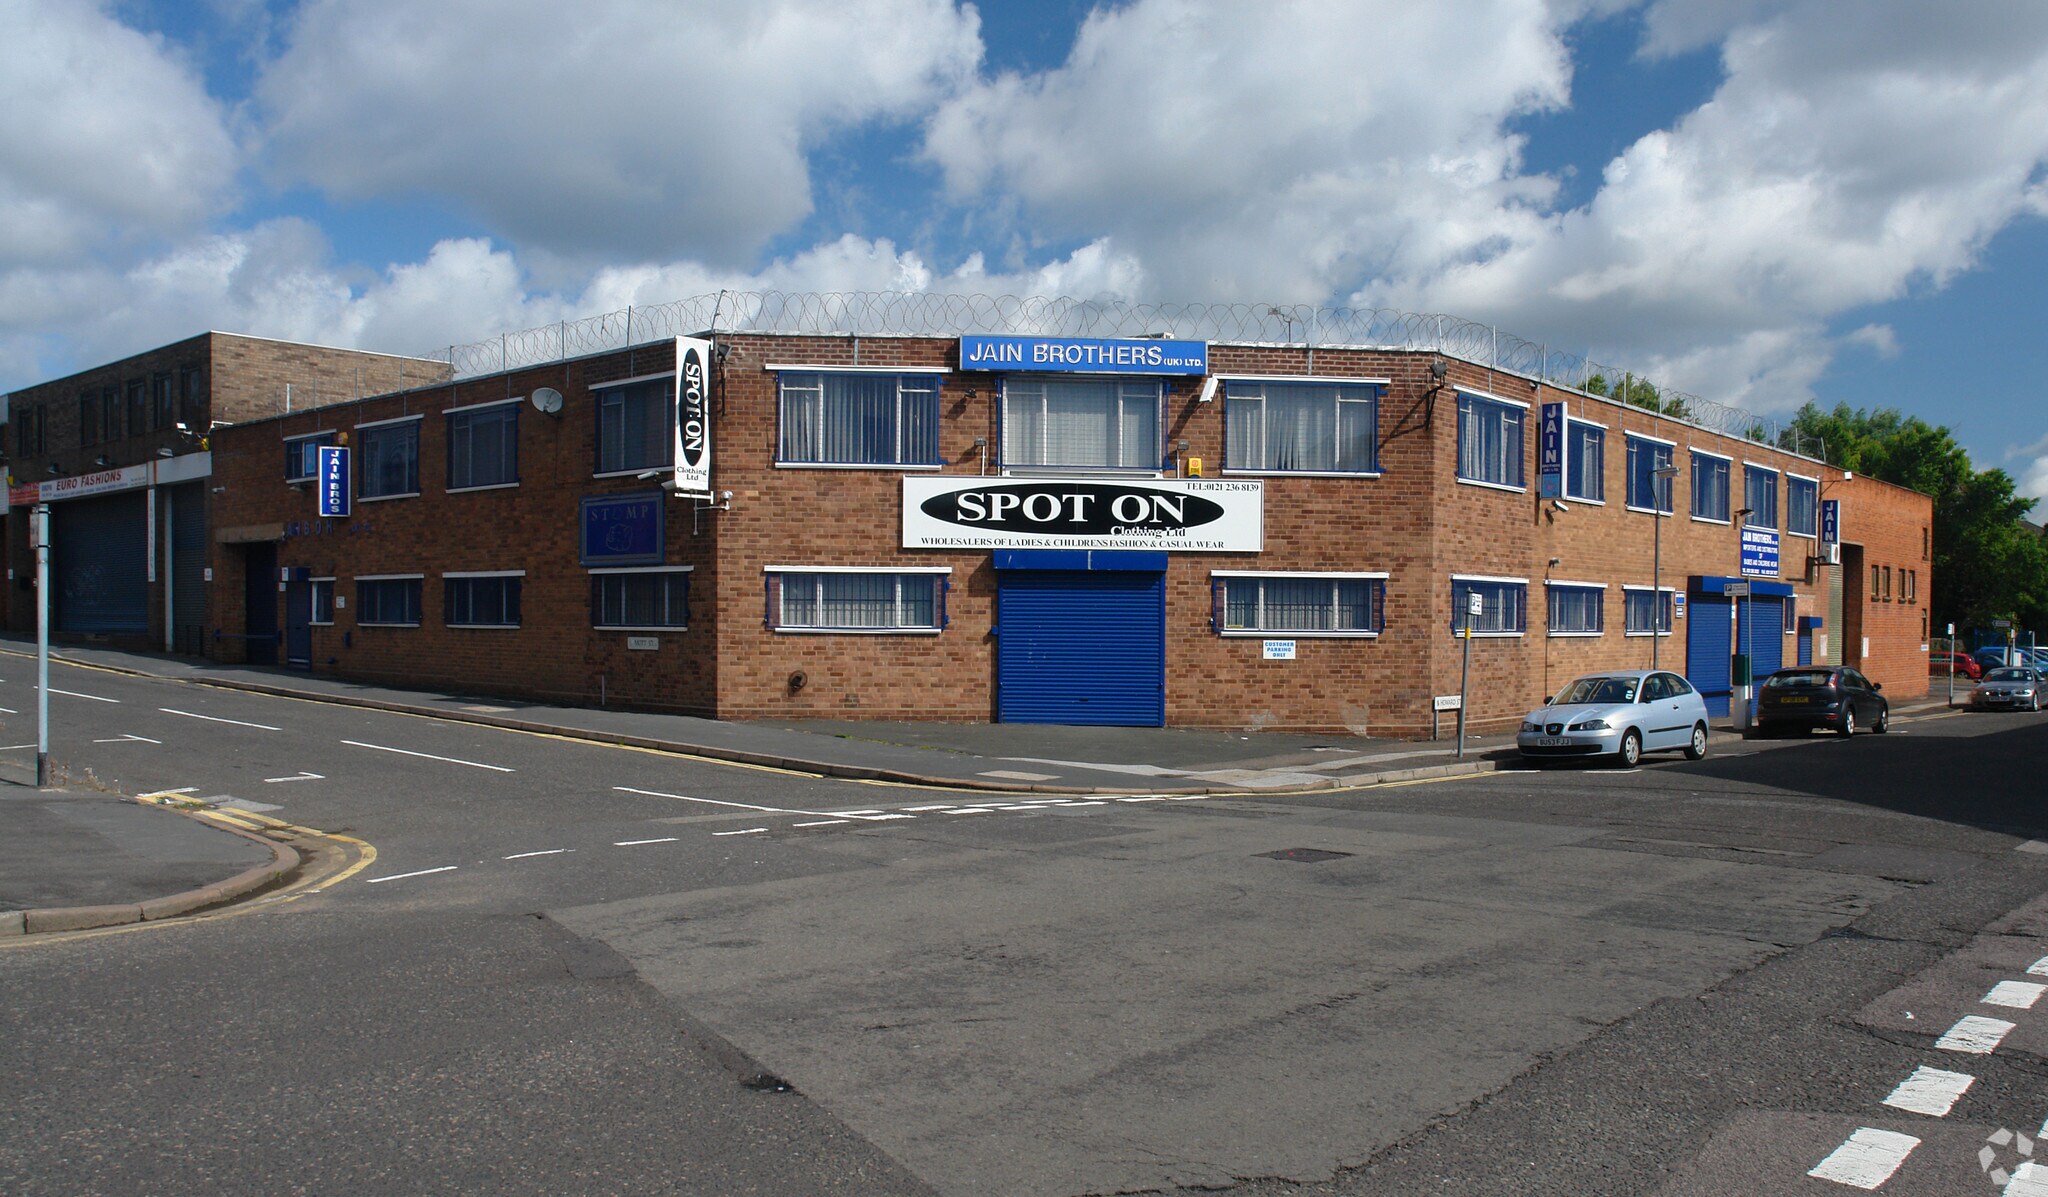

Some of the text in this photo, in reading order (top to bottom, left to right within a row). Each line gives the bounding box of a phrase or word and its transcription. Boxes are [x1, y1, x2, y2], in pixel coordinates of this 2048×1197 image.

[969, 343, 1203, 367] JAIN BROTHERS (UK) LTD.
[685, 363, 702, 452] SPOT ON
[1545, 404, 1558, 464] JAIN
[56, 478, 78, 491] EURO
[80, 470, 122, 488] FASHIONS
[329, 450, 341, 513] JAIN BROS
[676, 466, 707, 477] Clothing
[1226, 483, 1240, 491] 236
[1241, 483, 1259, 492] 8139
[957, 492, 1187, 524] SPOT ON
[1111, 525, 1186, 539] Clothing Ltd
[1824, 501, 1834, 541] JAIN
[921, 537, 1224, 549] WHOLESALERS OF LADIES & CHILDRENS FASHION & CASUAL WEAR
